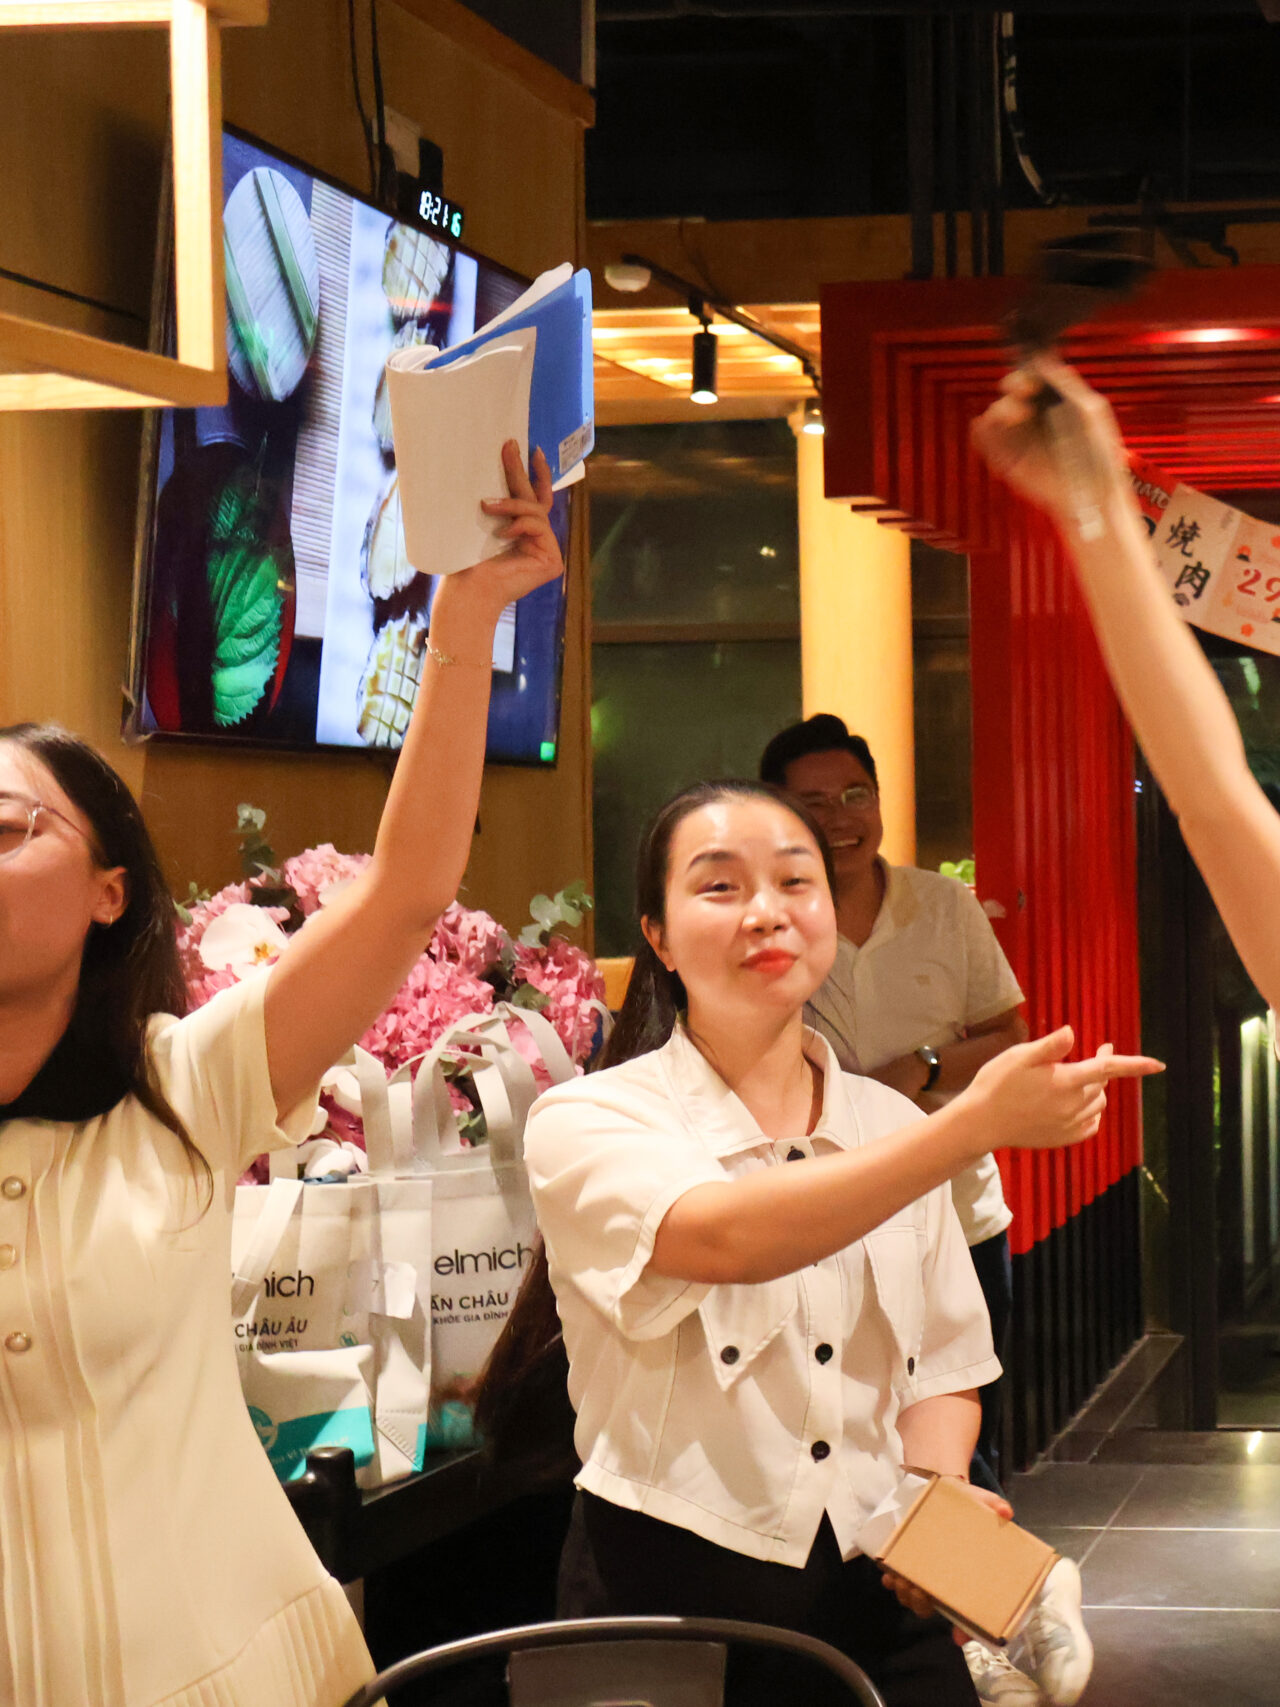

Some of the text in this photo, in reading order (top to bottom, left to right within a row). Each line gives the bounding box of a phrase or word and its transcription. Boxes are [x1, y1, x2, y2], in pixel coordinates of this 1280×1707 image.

[434, 1242, 535, 1276] elmich
[459, 1289, 509, 1310] CHÂU
[234, 1315, 308, 1338] CHÂU ÂU
